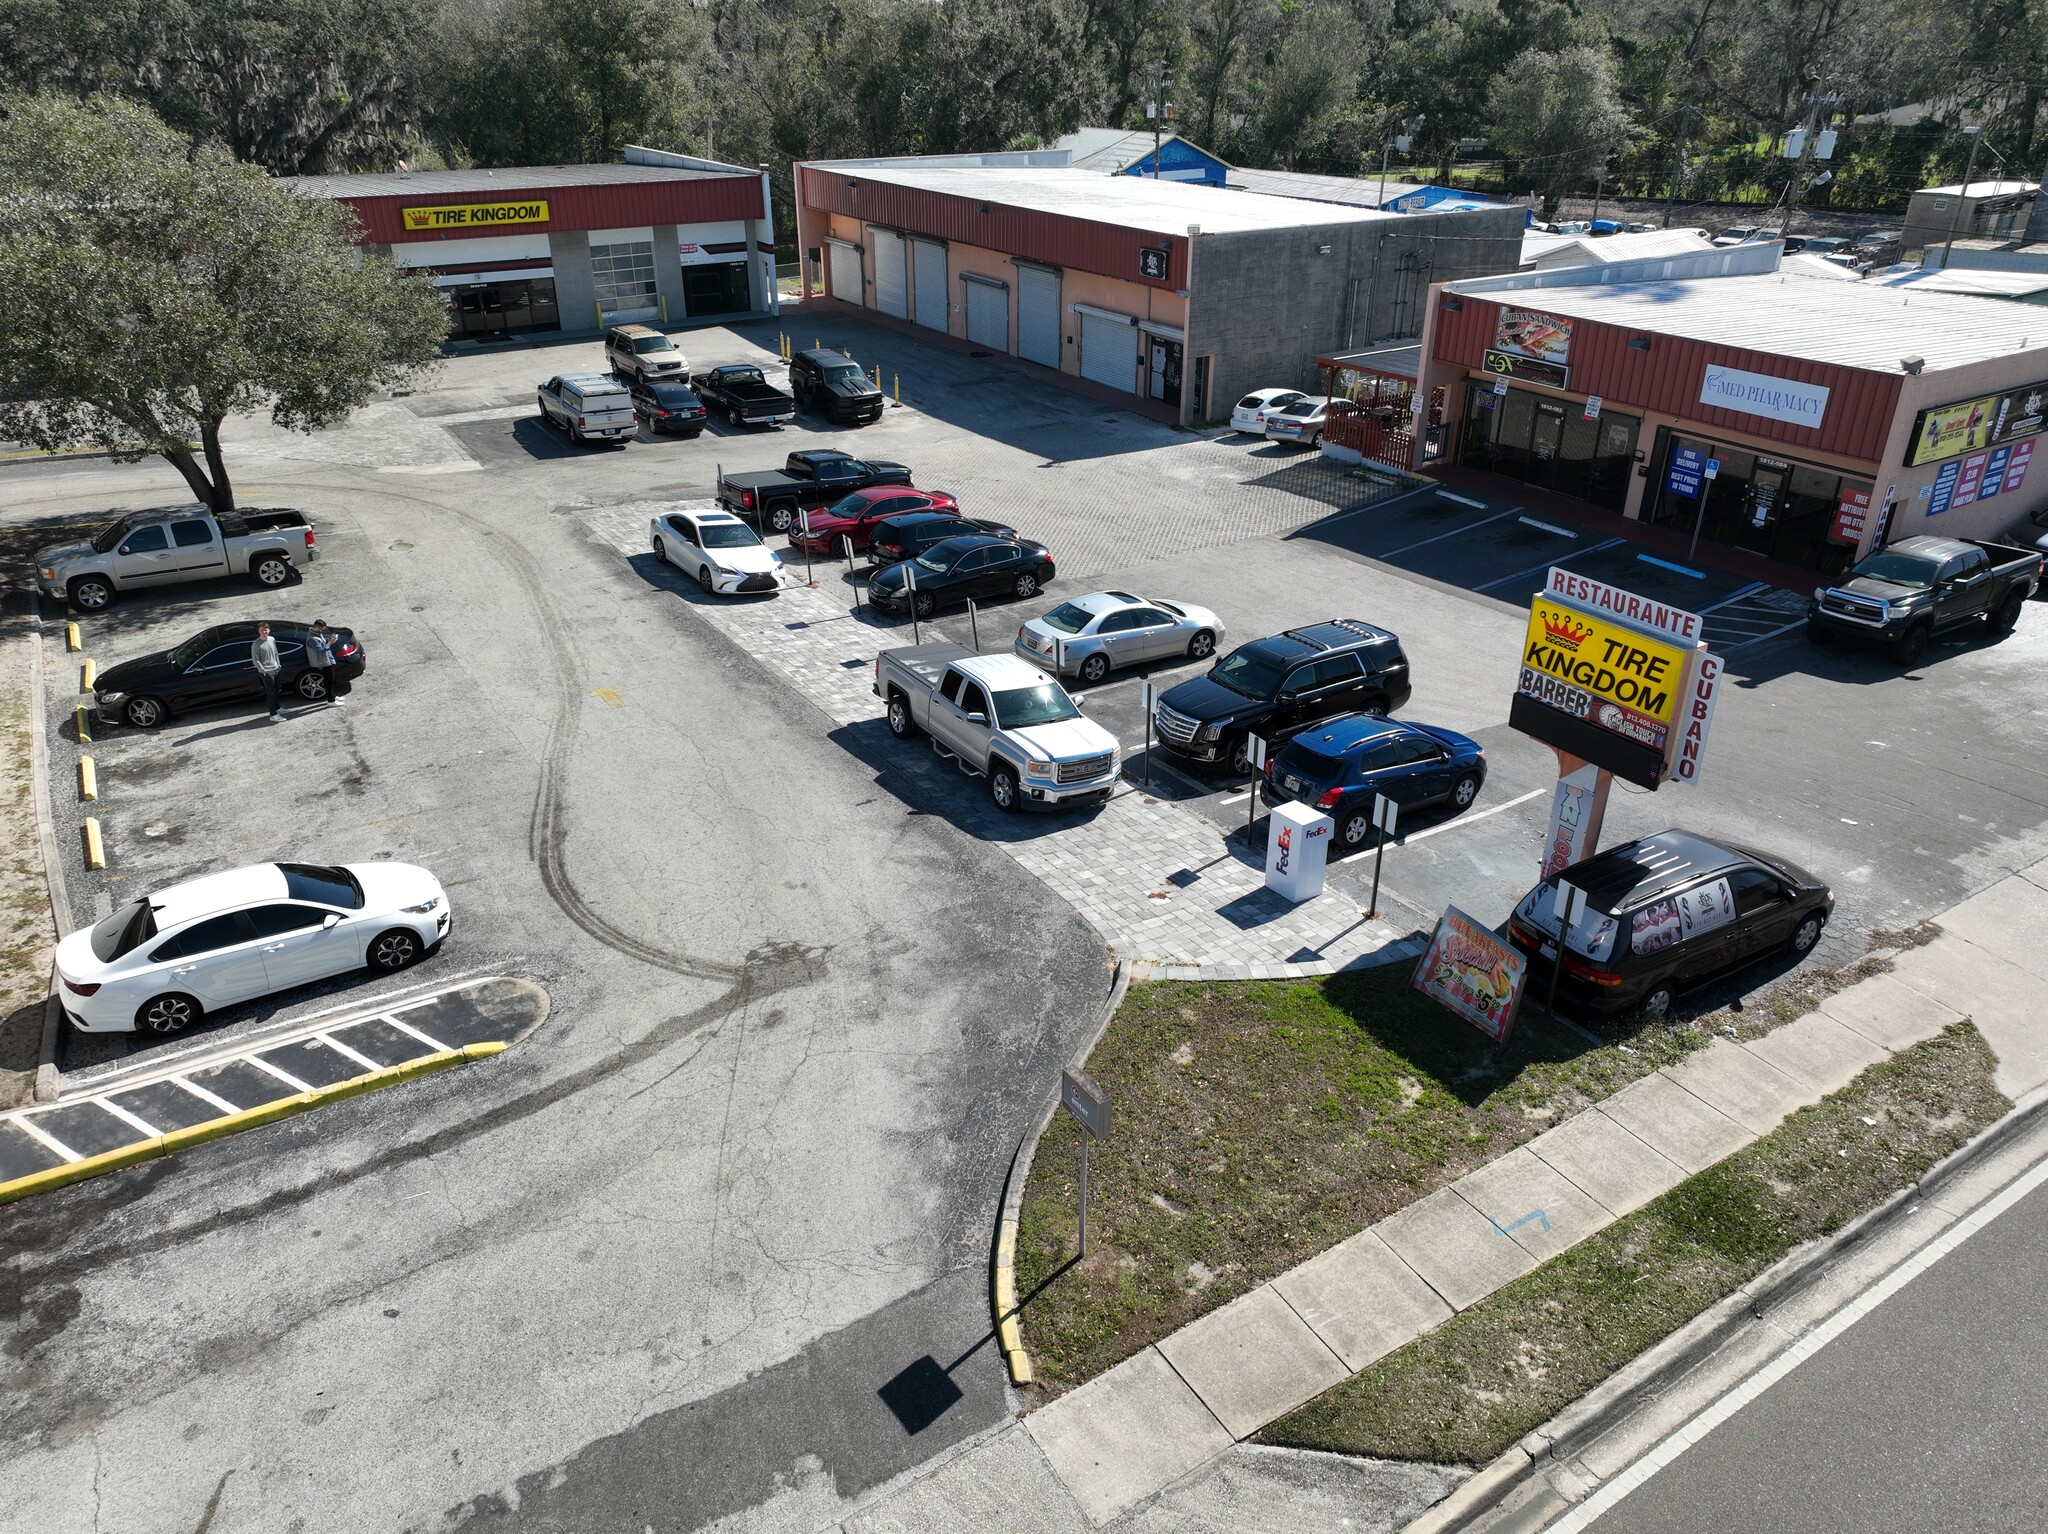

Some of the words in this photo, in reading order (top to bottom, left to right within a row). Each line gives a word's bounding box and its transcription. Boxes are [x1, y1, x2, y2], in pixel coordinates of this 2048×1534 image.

[433, 209, 467, 224] TIRE
[470, 205, 541, 222] KINGDOM
[1501, 312, 1528, 323] CUBAN
[1529, 313, 1571, 336] SANDWICH
[1676, 457, 1700, 471] DELIVERY
[1683, 450, 1697, 460] FREE
[1671, 471, 1684, 482] BEST
[1683, 475, 1699, 486] PRICE
[1678, 483, 1694, 494] TOWN
[1840, 502, 1867, 517] ANTIBIOT
[1854, 494, 1869, 505] FREE
[1839, 514, 1852, 526] AND
[1851, 517, 1865, 528] OTH
[1553, 571, 1696, 639] RESTAURANTE
[1602, 638, 1671, 684] TIRE
[1526, 641, 1668, 715] KINGDOM
[1521, 668, 1589, 717] BARBER
[1608, 714, 1635, 731] ENGLISH
[1635, 726, 1656, 740] TOUCH
[1626, 712, 1667, 734] 813.408.1370
[1678, 659, 1718, 779] CUBANO
[1306, 826, 1328, 839] FedEx
[1276, 825, 1292, 876] FedEx
[1448, 914, 1520, 972] BREAKFASTS
